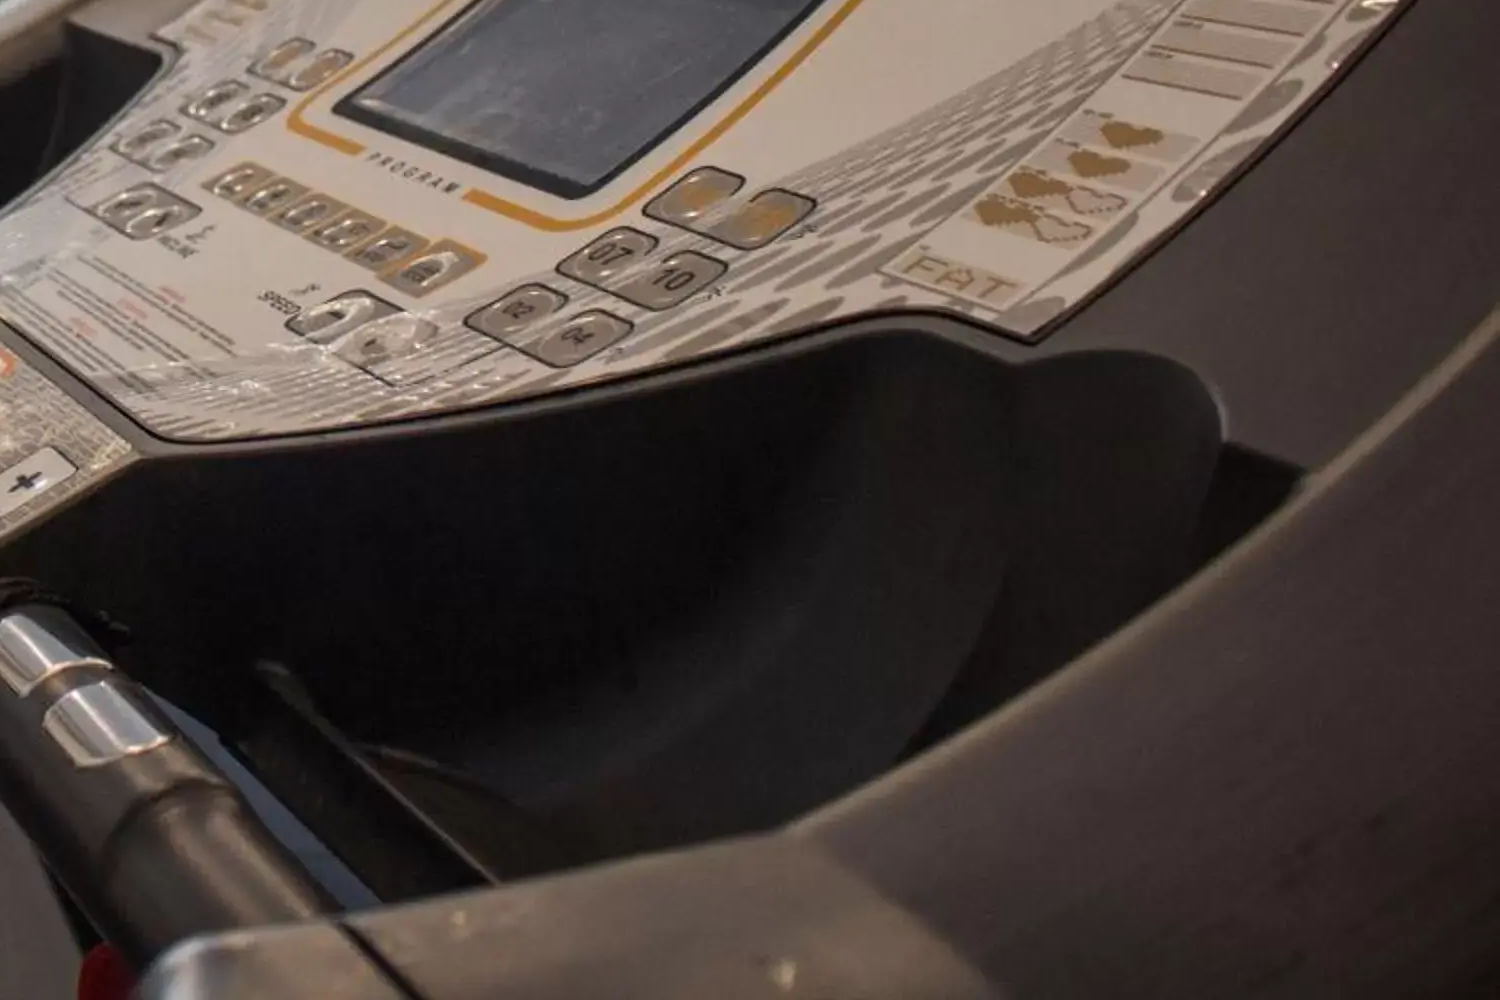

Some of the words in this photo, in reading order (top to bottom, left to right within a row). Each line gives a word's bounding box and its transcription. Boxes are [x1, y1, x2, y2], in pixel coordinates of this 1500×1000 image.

[367, 151, 461, 194] PROGRAM
[586, 243, 633, 266] 07
[651, 267, 695, 292] 10
[904, 256, 1017, 298] FAT
